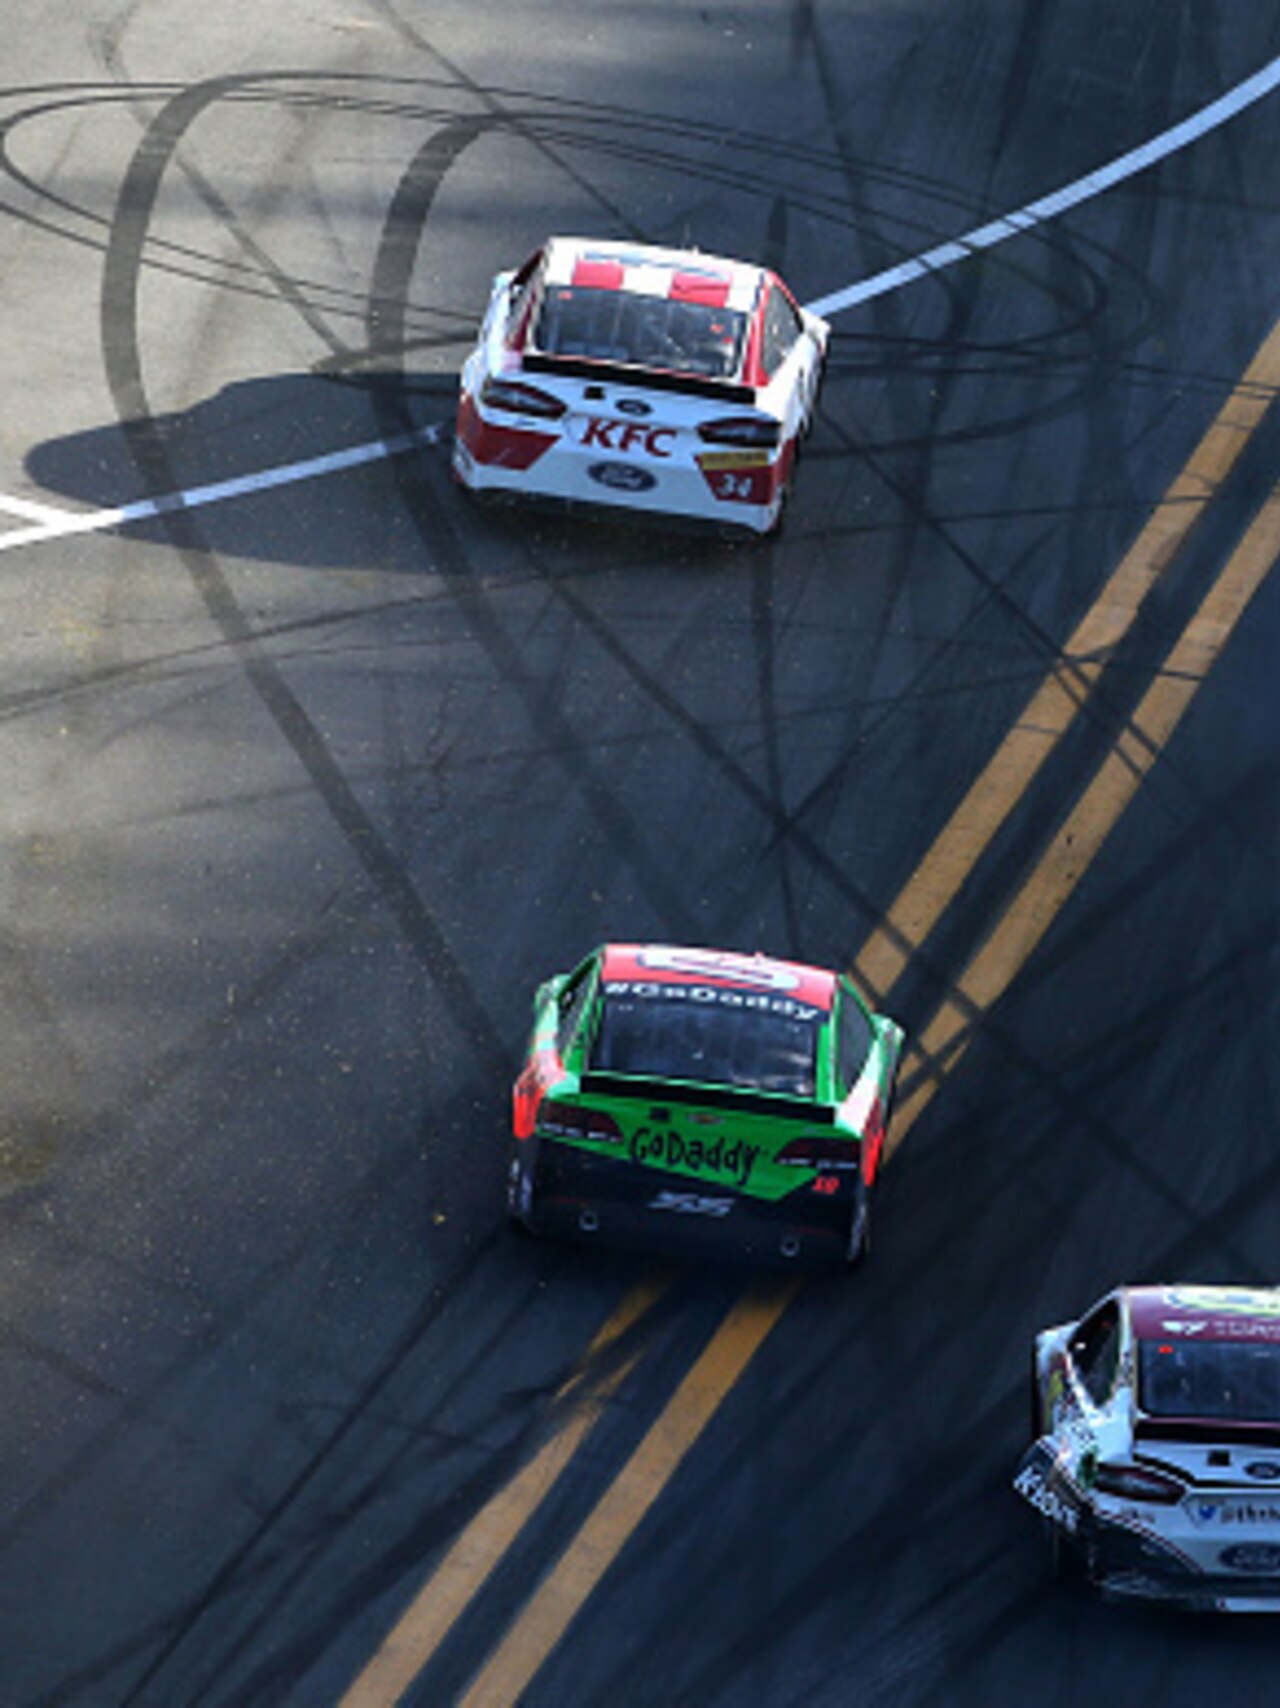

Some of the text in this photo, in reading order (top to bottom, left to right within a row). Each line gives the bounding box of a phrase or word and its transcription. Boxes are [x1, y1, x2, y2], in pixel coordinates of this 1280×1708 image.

[581, 416, 678, 458] KFC
[716, 473, 752, 498] 34
[605, 981, 819, 1021] #GoDaddy
[630, 1126, 760, 1187] GoDaddy
